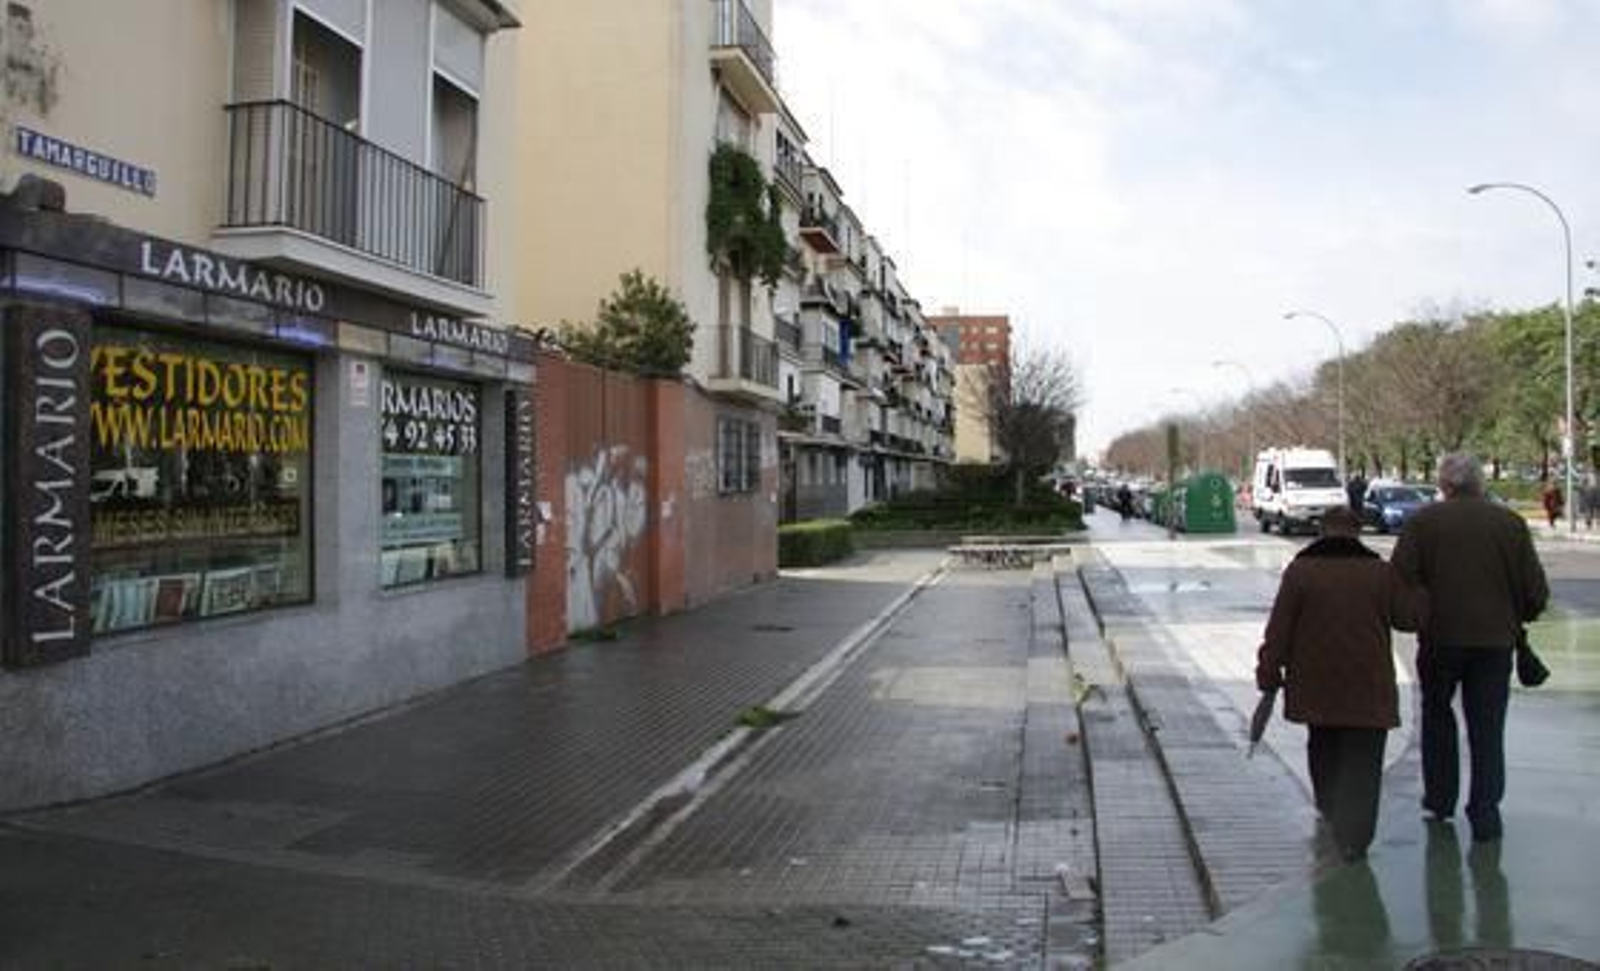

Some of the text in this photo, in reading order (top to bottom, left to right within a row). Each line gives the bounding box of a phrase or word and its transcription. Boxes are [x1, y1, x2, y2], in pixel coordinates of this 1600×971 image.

[20, 130, 156, 193] TAMARGUILLO
[140, 241, 324, 311] LARMARIO
[411, 313, 509, 353] LARMARIO
[405, 420, 428, 449] 92
[32, 329, 80, 643] LARMARIO
